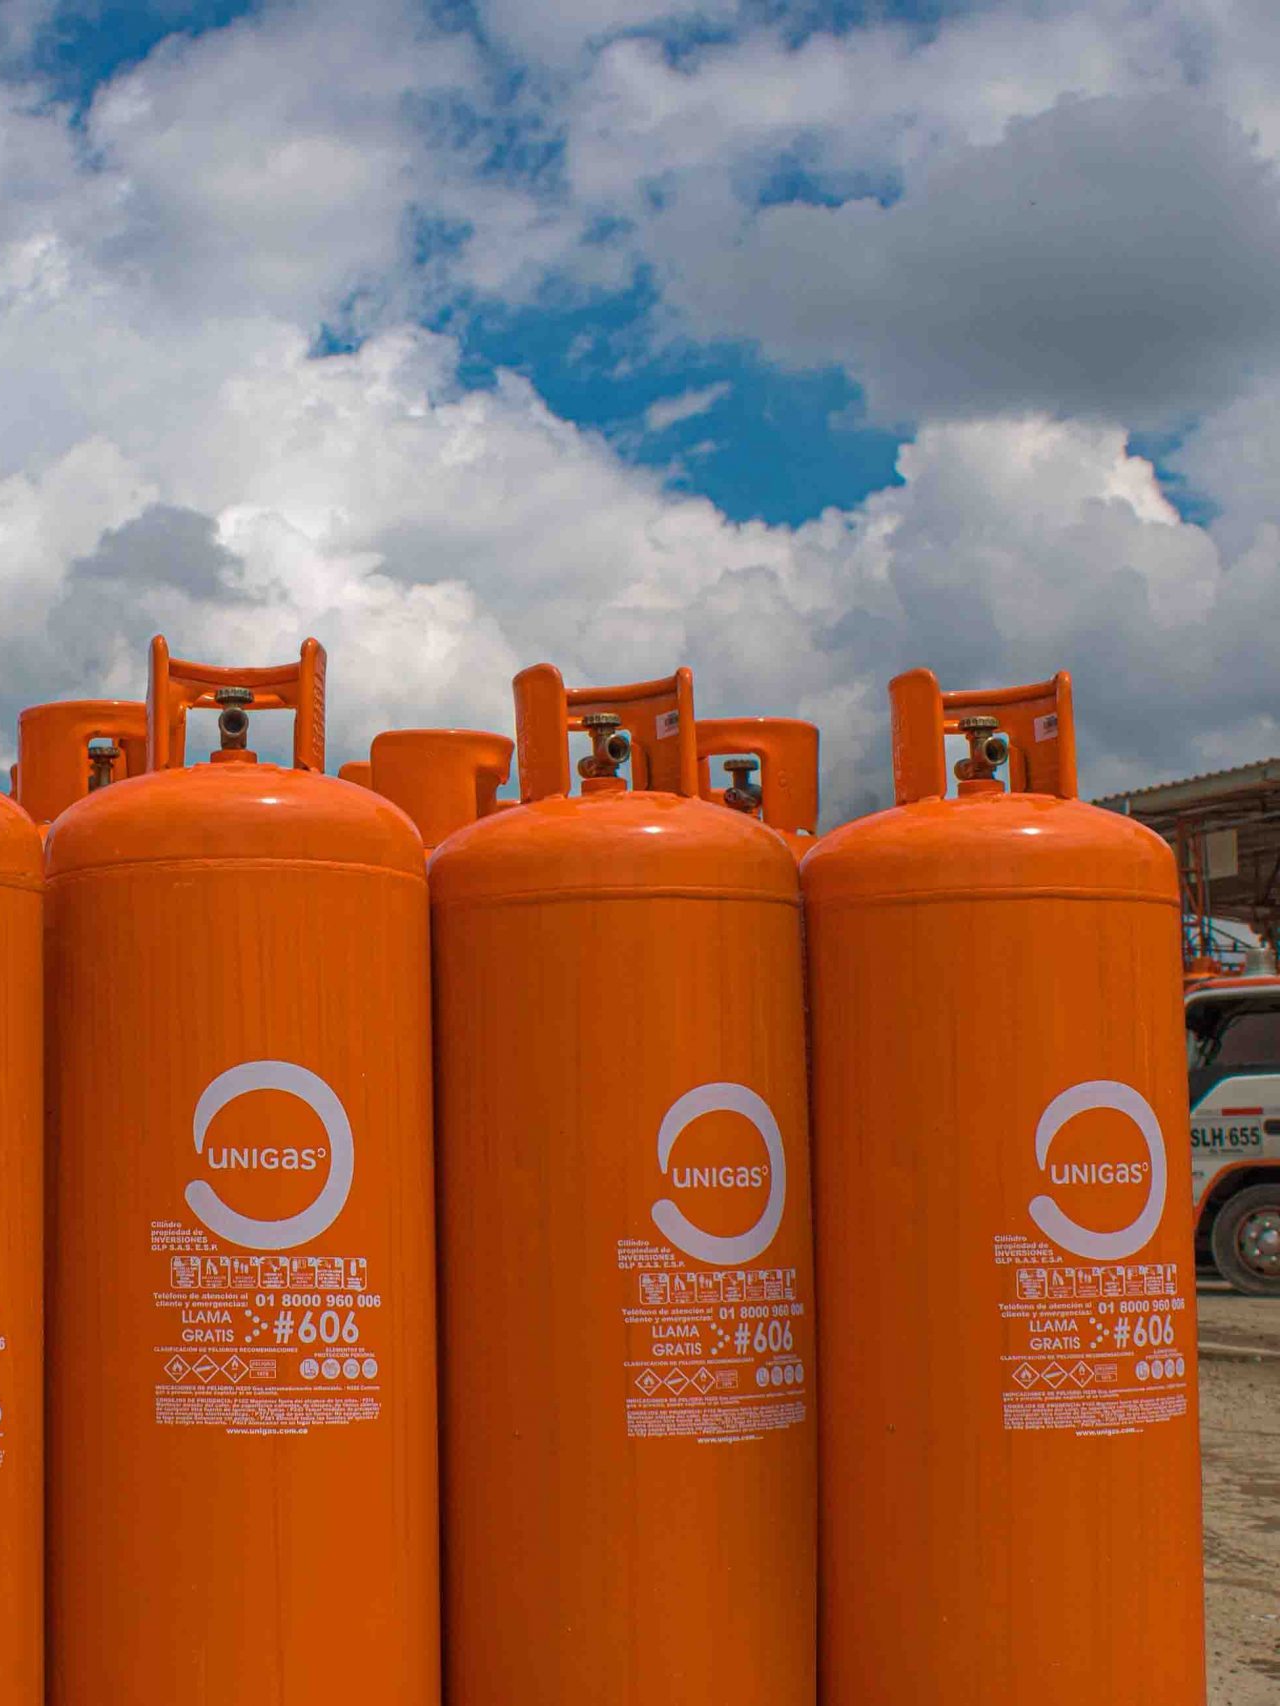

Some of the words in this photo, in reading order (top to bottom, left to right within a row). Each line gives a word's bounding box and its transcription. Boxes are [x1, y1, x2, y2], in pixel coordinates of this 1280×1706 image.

[255, 1293, 274, 1307] 01
[281, 1293, 321, 1307] 8000
[326, 1294, 354, 1307] 960
[357, 1294, 381, 1307] 006
[1098, 1301, 1114, 1315] 01
[1120, 1300, 1149, 1313] 8000
[1152, 1299, 1170, 1312] 960
[182, 1310, 232, 1324] LLAMA
[719, 1306, 735, 1320] 01
[740, 1305, 769, 1319] 8000
[772, 1304, 789, 1317] 960
[273, 1310, 359, 1344] #606
[652, 1324, 700, 1338] LLAMA
[1029, 1318, 1078, 1332] LLAMA
[1114, 1314, 1174, 1349] #606
[182, 1329, 235, 1342] GRATIS
[734, 1320, 793, 1355] #606
[652, 1342, 702, 1356] GRATIS
[1030, 1336, 1080, 1351] GRATIS
